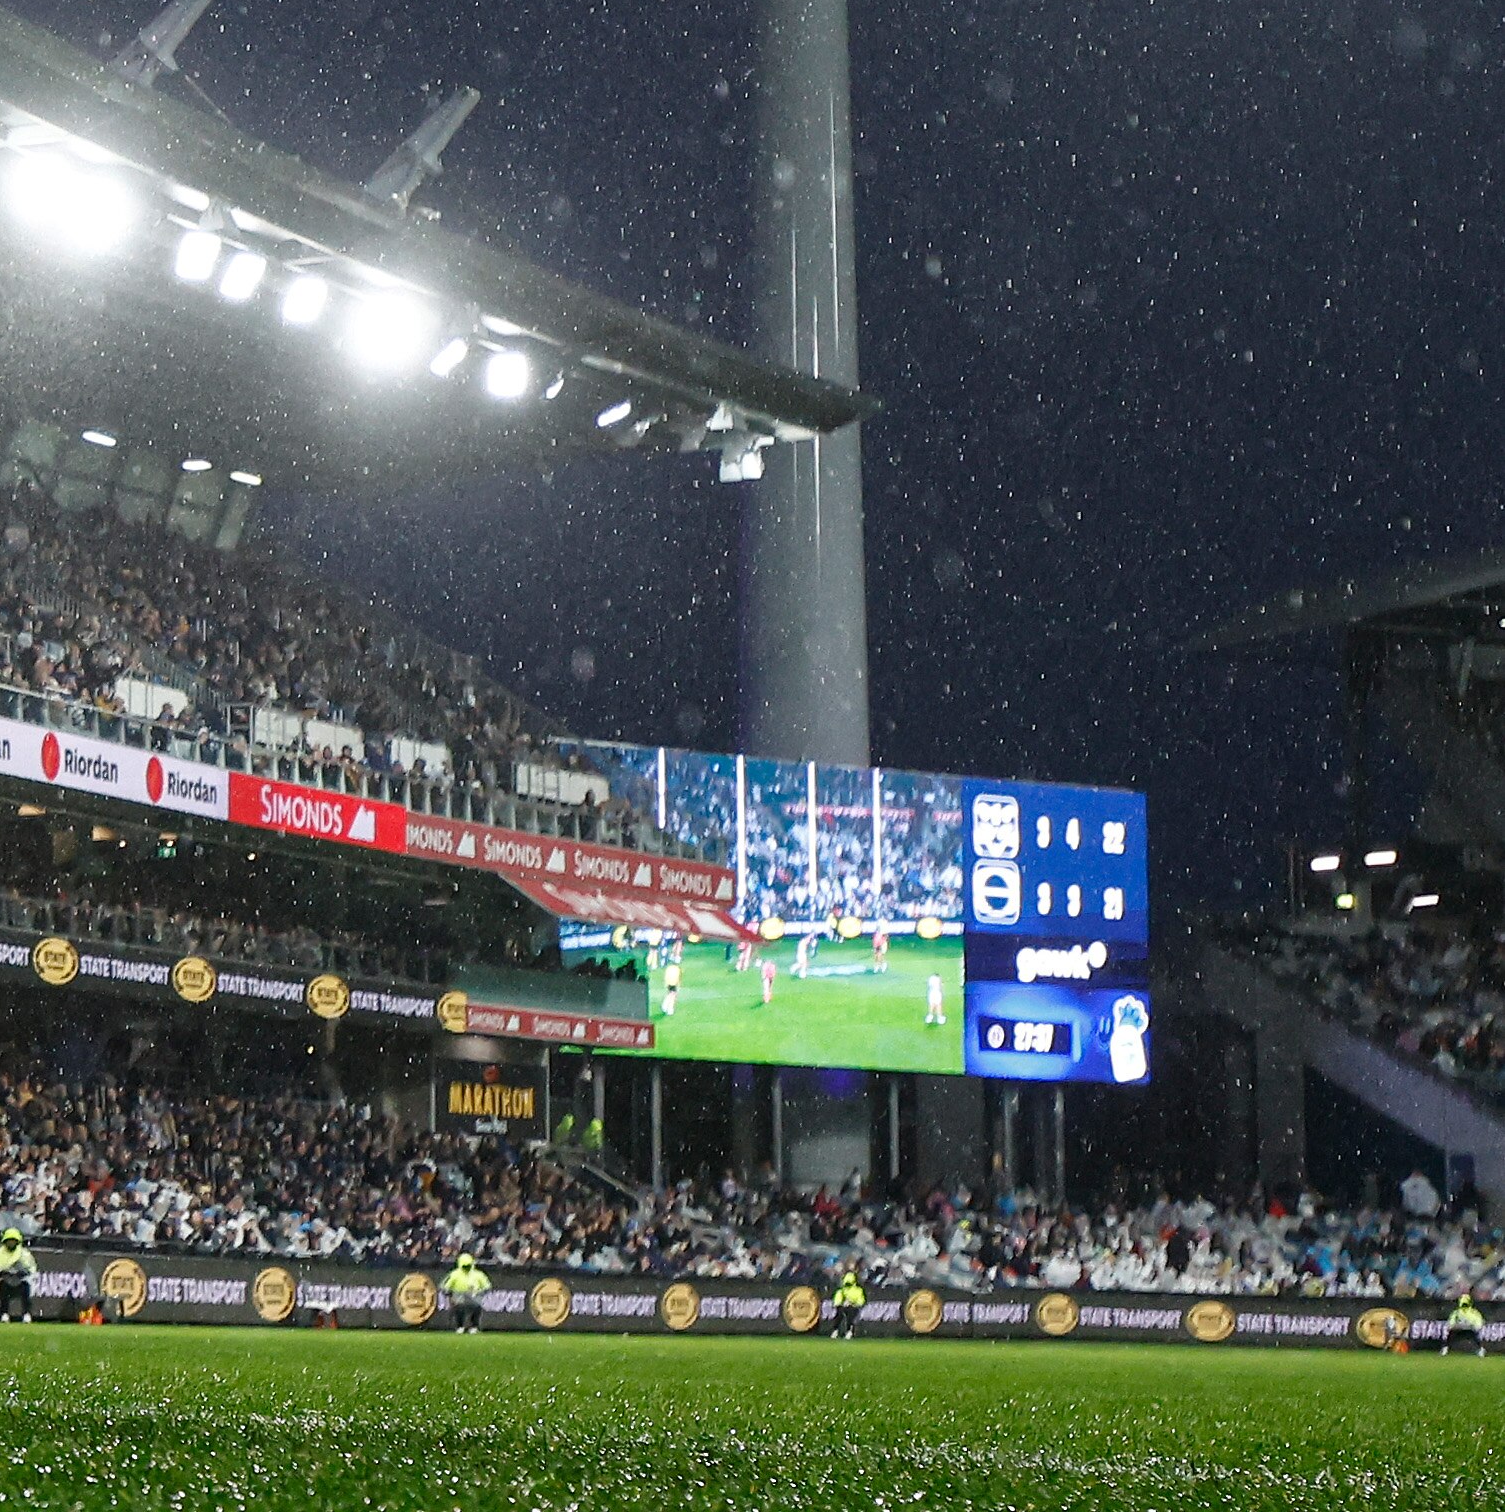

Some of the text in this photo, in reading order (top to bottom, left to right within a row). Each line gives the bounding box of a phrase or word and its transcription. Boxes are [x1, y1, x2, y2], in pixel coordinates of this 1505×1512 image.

[64, 747, 119, 785] Riordan
[167, 770, 218, 804] Riordan
[260, 784, 343, 835] SIMONDS
[406, 824, 453, 855] IMONDS
[484, 834, 542, 870] SIMONDS
[80, 955, 170, 985] STATE TRANSPORT
[218, 974, 305, 1003] STATE TRANSPORT
[351, 990, 379, 1011] STATE
[380, 993, 436, 1018] TRANSPORT
[147, 1277, 182, 1301] STATE
[183, 1279, 246, 1305] TRANSPORT
